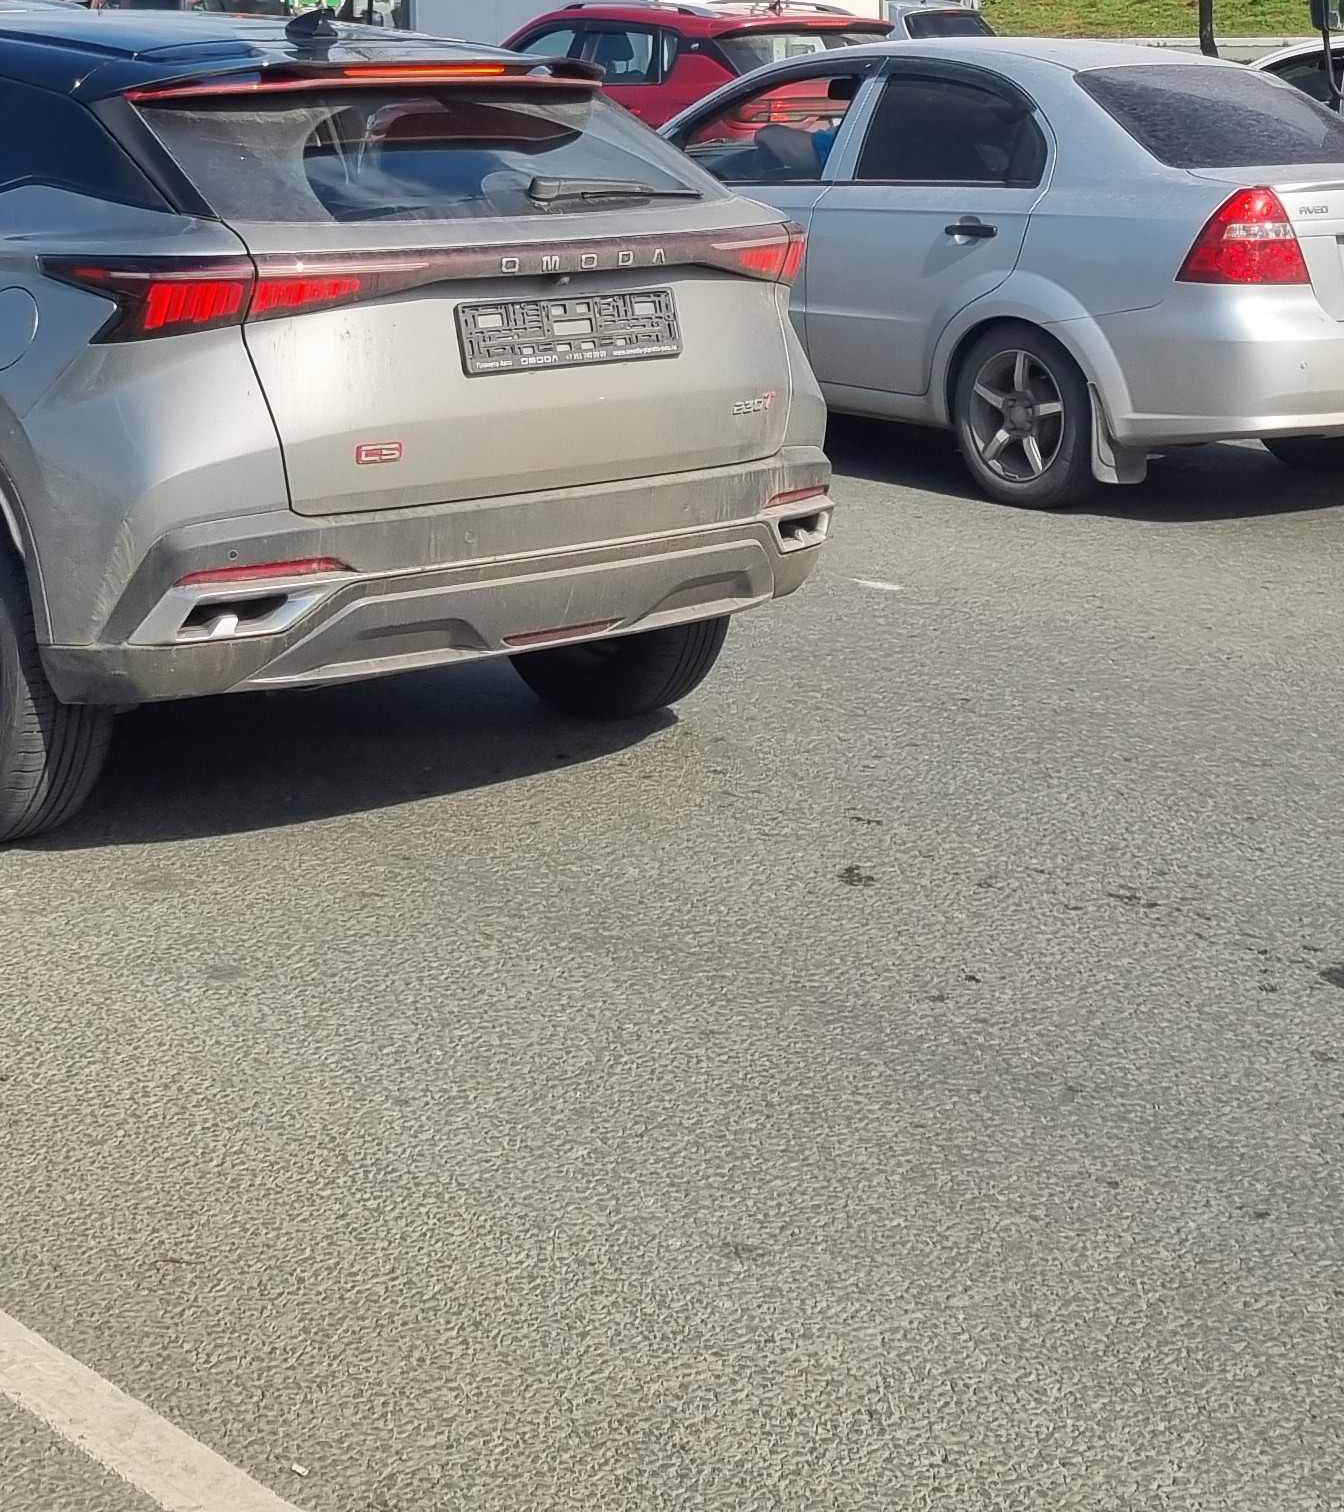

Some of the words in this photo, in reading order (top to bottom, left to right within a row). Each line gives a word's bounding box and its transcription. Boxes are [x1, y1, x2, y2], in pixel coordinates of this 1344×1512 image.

[1299, 205, 1329, 215] AVEO
[501, 248, 666, 273] OMODA
[520, 355, 559, 365] OMODA
